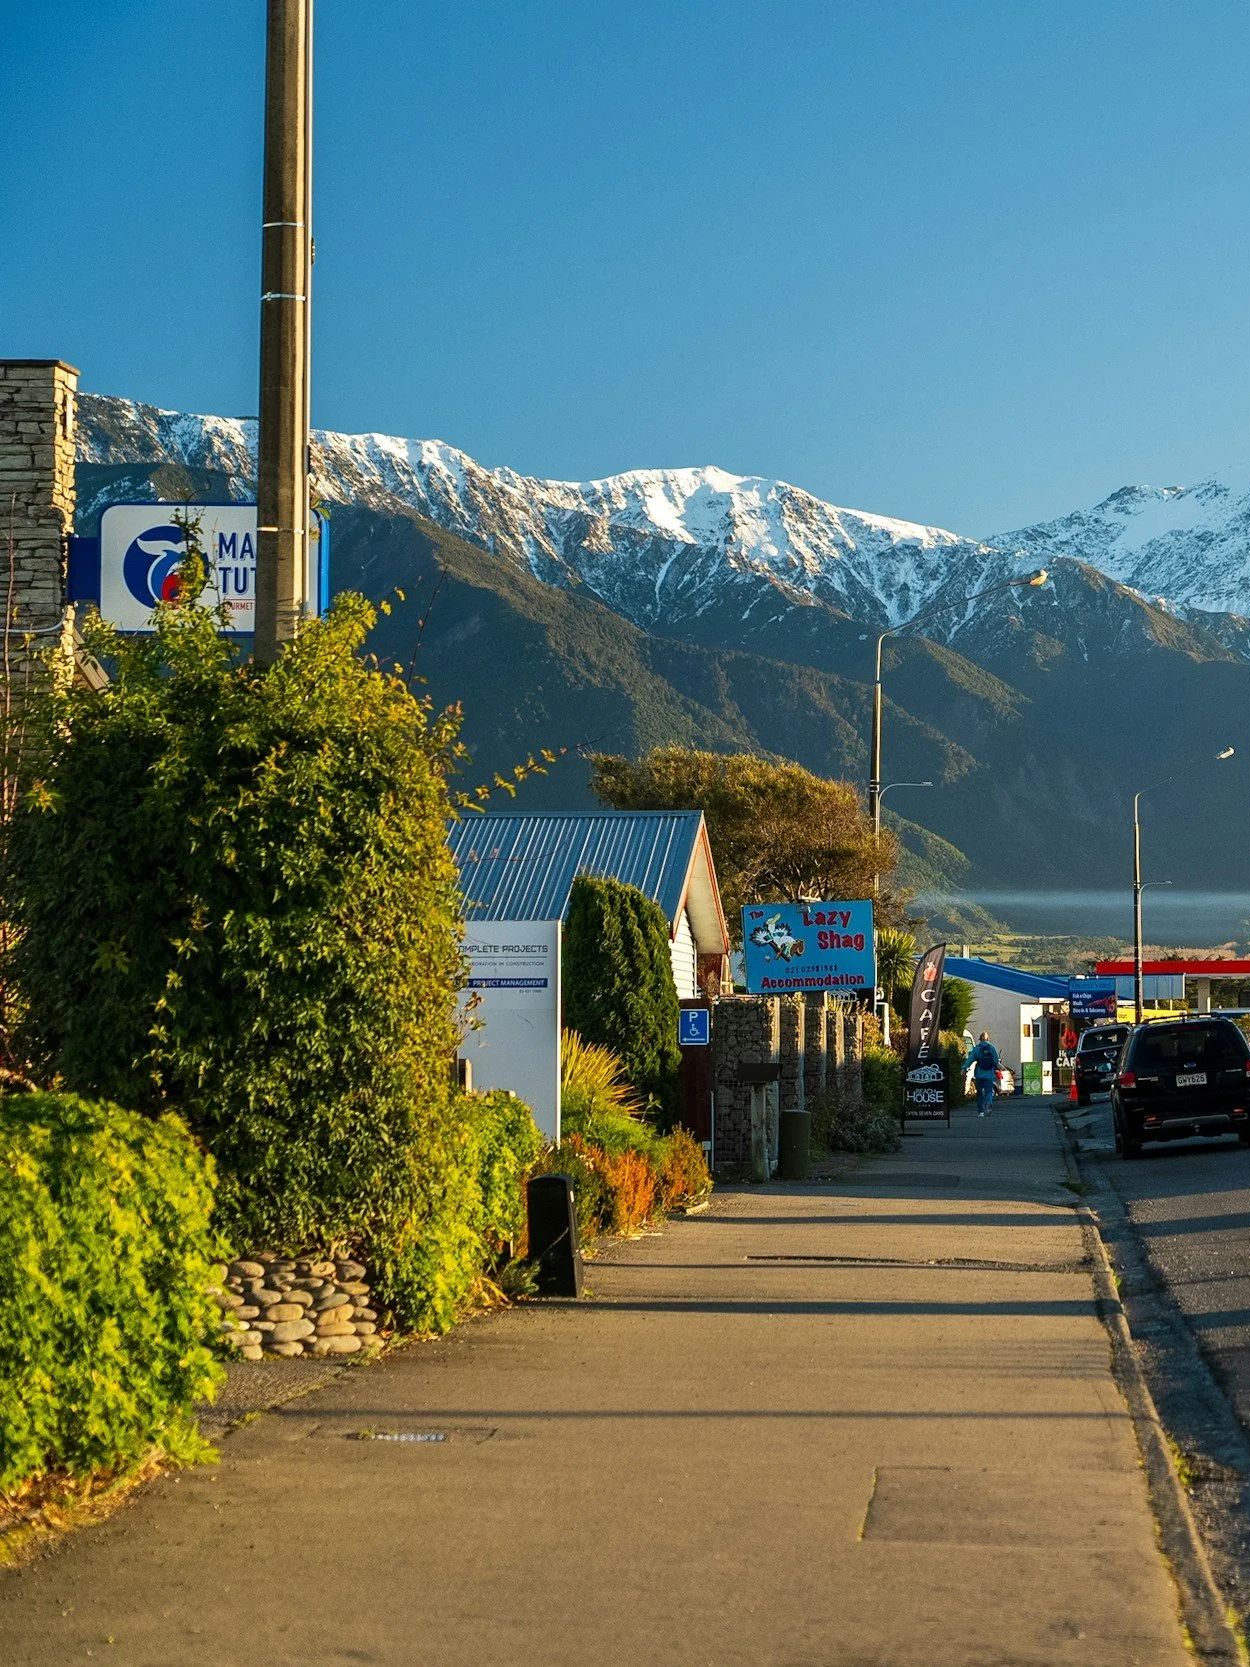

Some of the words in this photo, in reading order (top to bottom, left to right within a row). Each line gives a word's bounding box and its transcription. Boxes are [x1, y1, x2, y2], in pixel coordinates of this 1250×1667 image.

[225, 602, 254, 610] OURMET
[749, 910, 764, 919] The
[802, 911, 852, 929] Lazy
[817, 930, 865, 951] Shag
[502, 945, 548, 953] PROJECTS
[785, 966, 799, 974] 021
[501, 979, 544, 987] MANAGEMENT
[761, 973, 865, 989] Accommodation
[689, 1011, 699, 1023] P
[906, 1090, 944, 1103] HOUSE
